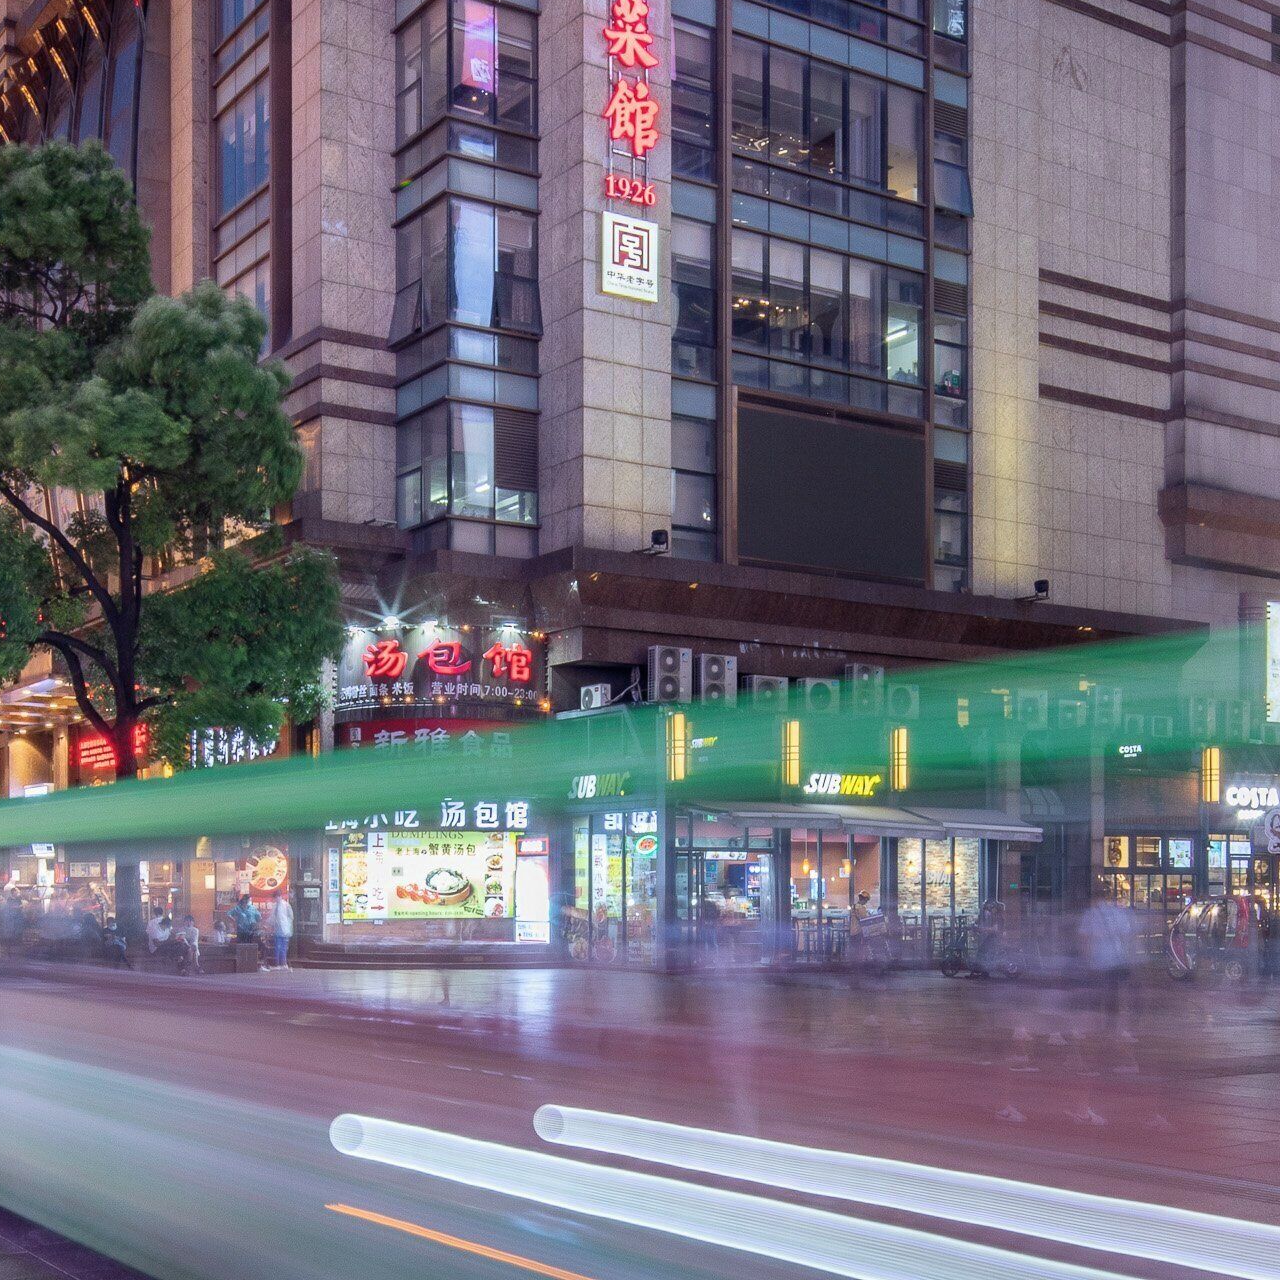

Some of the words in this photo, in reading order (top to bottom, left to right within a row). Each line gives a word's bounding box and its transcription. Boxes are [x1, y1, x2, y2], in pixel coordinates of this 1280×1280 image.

[605, 173, 656, 206] 1926
[362, 636, 533, 684] 汤包馆
[392, 681, 415, 696] 米饭
[431, 681, 481, 696] 营业时间
[374, 727, 513, 758] 新雅食品
[690, 736, 718, 749] SUBWAY
[1119, 744, 1143, 754] COSTA
[569, 772, 631, 800] SUBWAY
[803, 773, 882, 796] SUBWAY
[1226, 786, 1279, 809] COSTA
[439, 798, 529, 829] 汤包馆
[391, 831, 464, 840] DUMPLINGS
